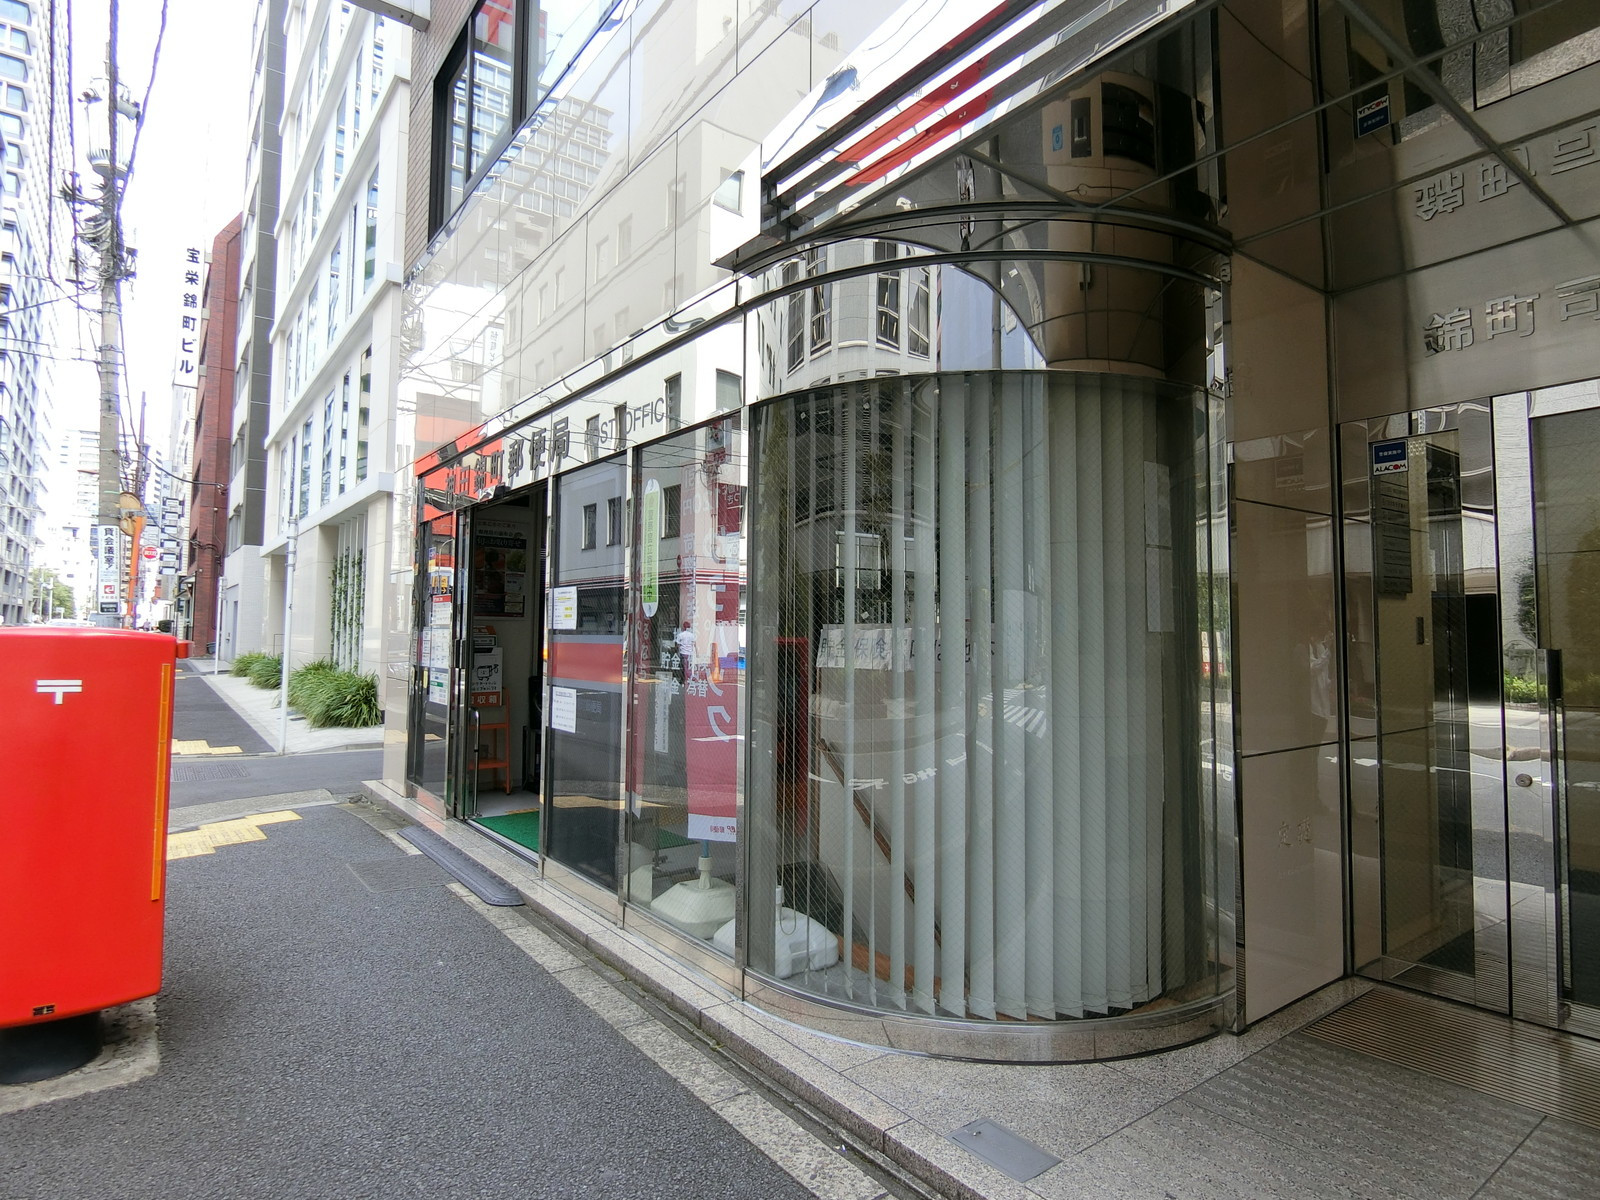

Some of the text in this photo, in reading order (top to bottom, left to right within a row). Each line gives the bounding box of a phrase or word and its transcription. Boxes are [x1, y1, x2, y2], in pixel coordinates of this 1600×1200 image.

[180, 247, 201, 374] 宝栄錦町ビル
